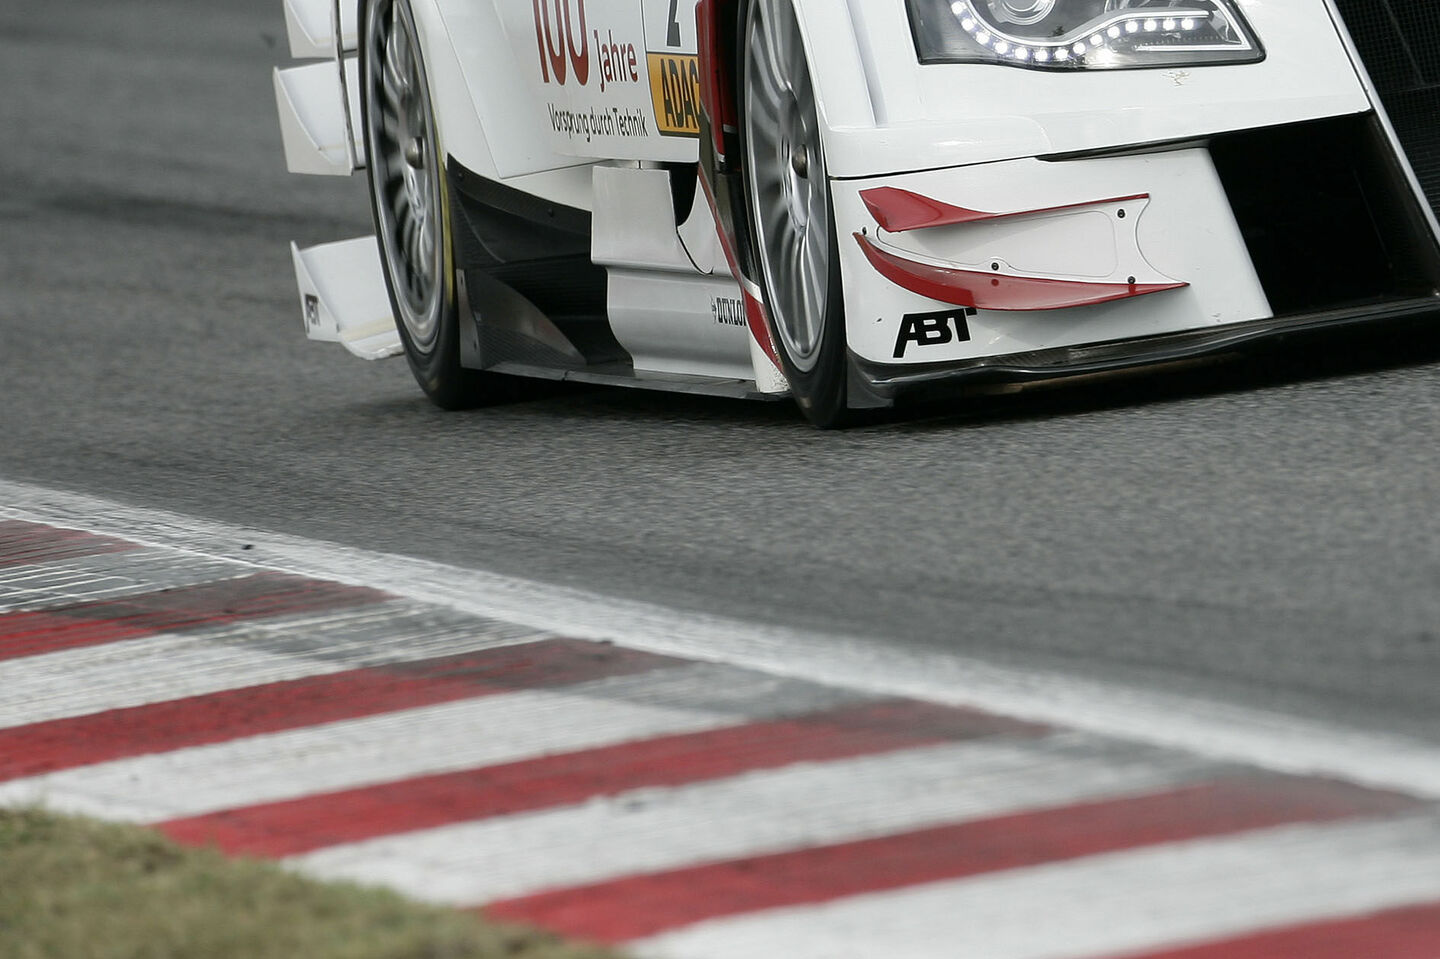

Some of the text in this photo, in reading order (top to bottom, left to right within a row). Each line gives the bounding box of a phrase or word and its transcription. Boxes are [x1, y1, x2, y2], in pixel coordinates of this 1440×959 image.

[594, 29, 638, 92] Jahre
[547, 103, 649, 142] Vorsprung durch Technik
[892, 307, 977, 359] ABT
